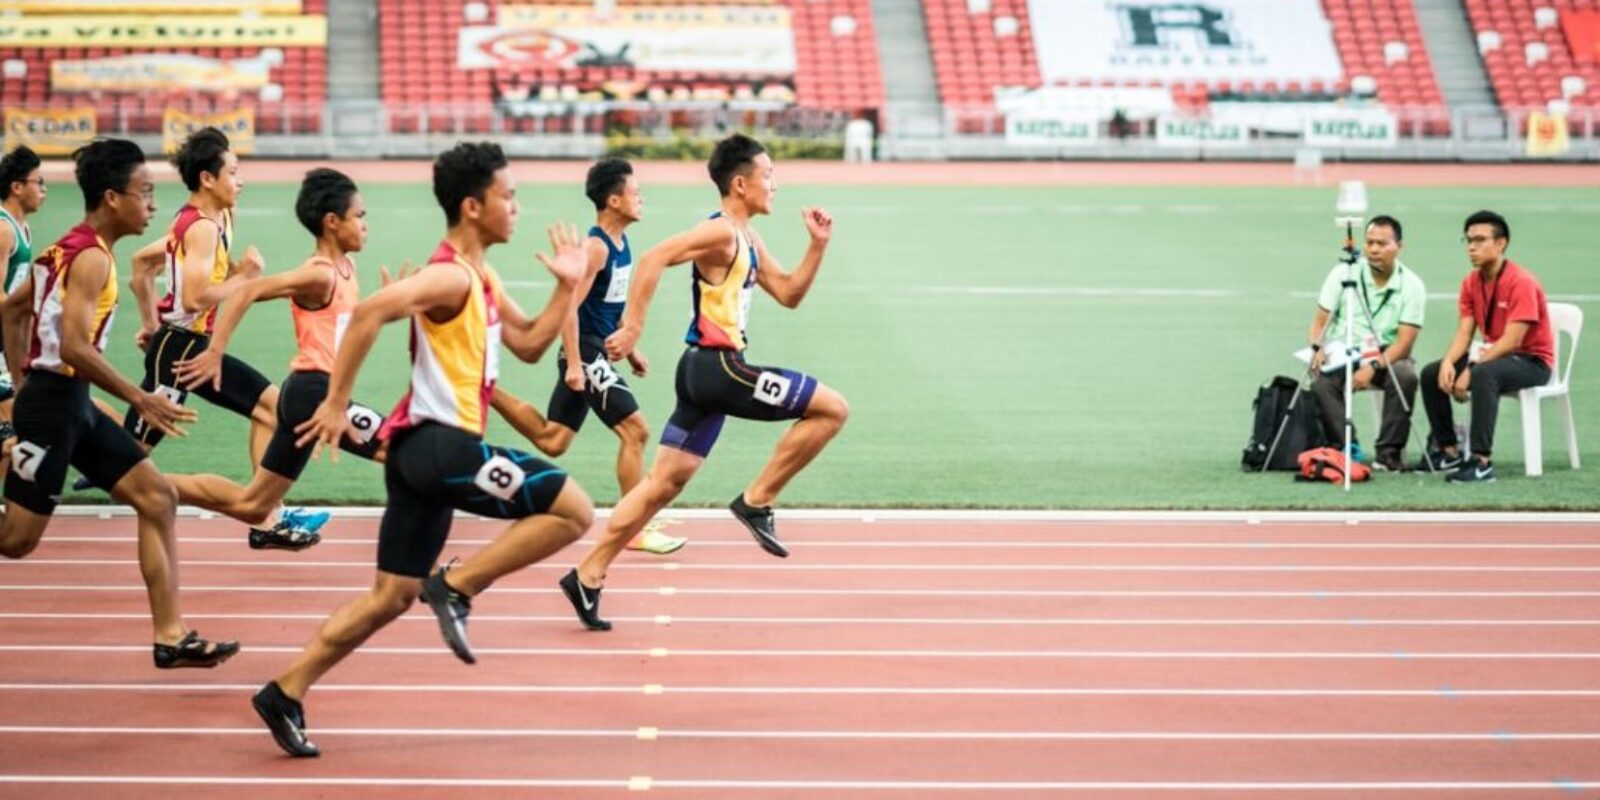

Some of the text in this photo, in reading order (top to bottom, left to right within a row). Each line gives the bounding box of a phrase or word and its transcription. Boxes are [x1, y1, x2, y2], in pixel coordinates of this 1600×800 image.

[593, 366, 611, 384] 2
[762, 379, 782, 398] 5
[351, 413, 372, 431] 6
[17, 447, 34, 468] 7
[488, 465, 514, 488] 8
